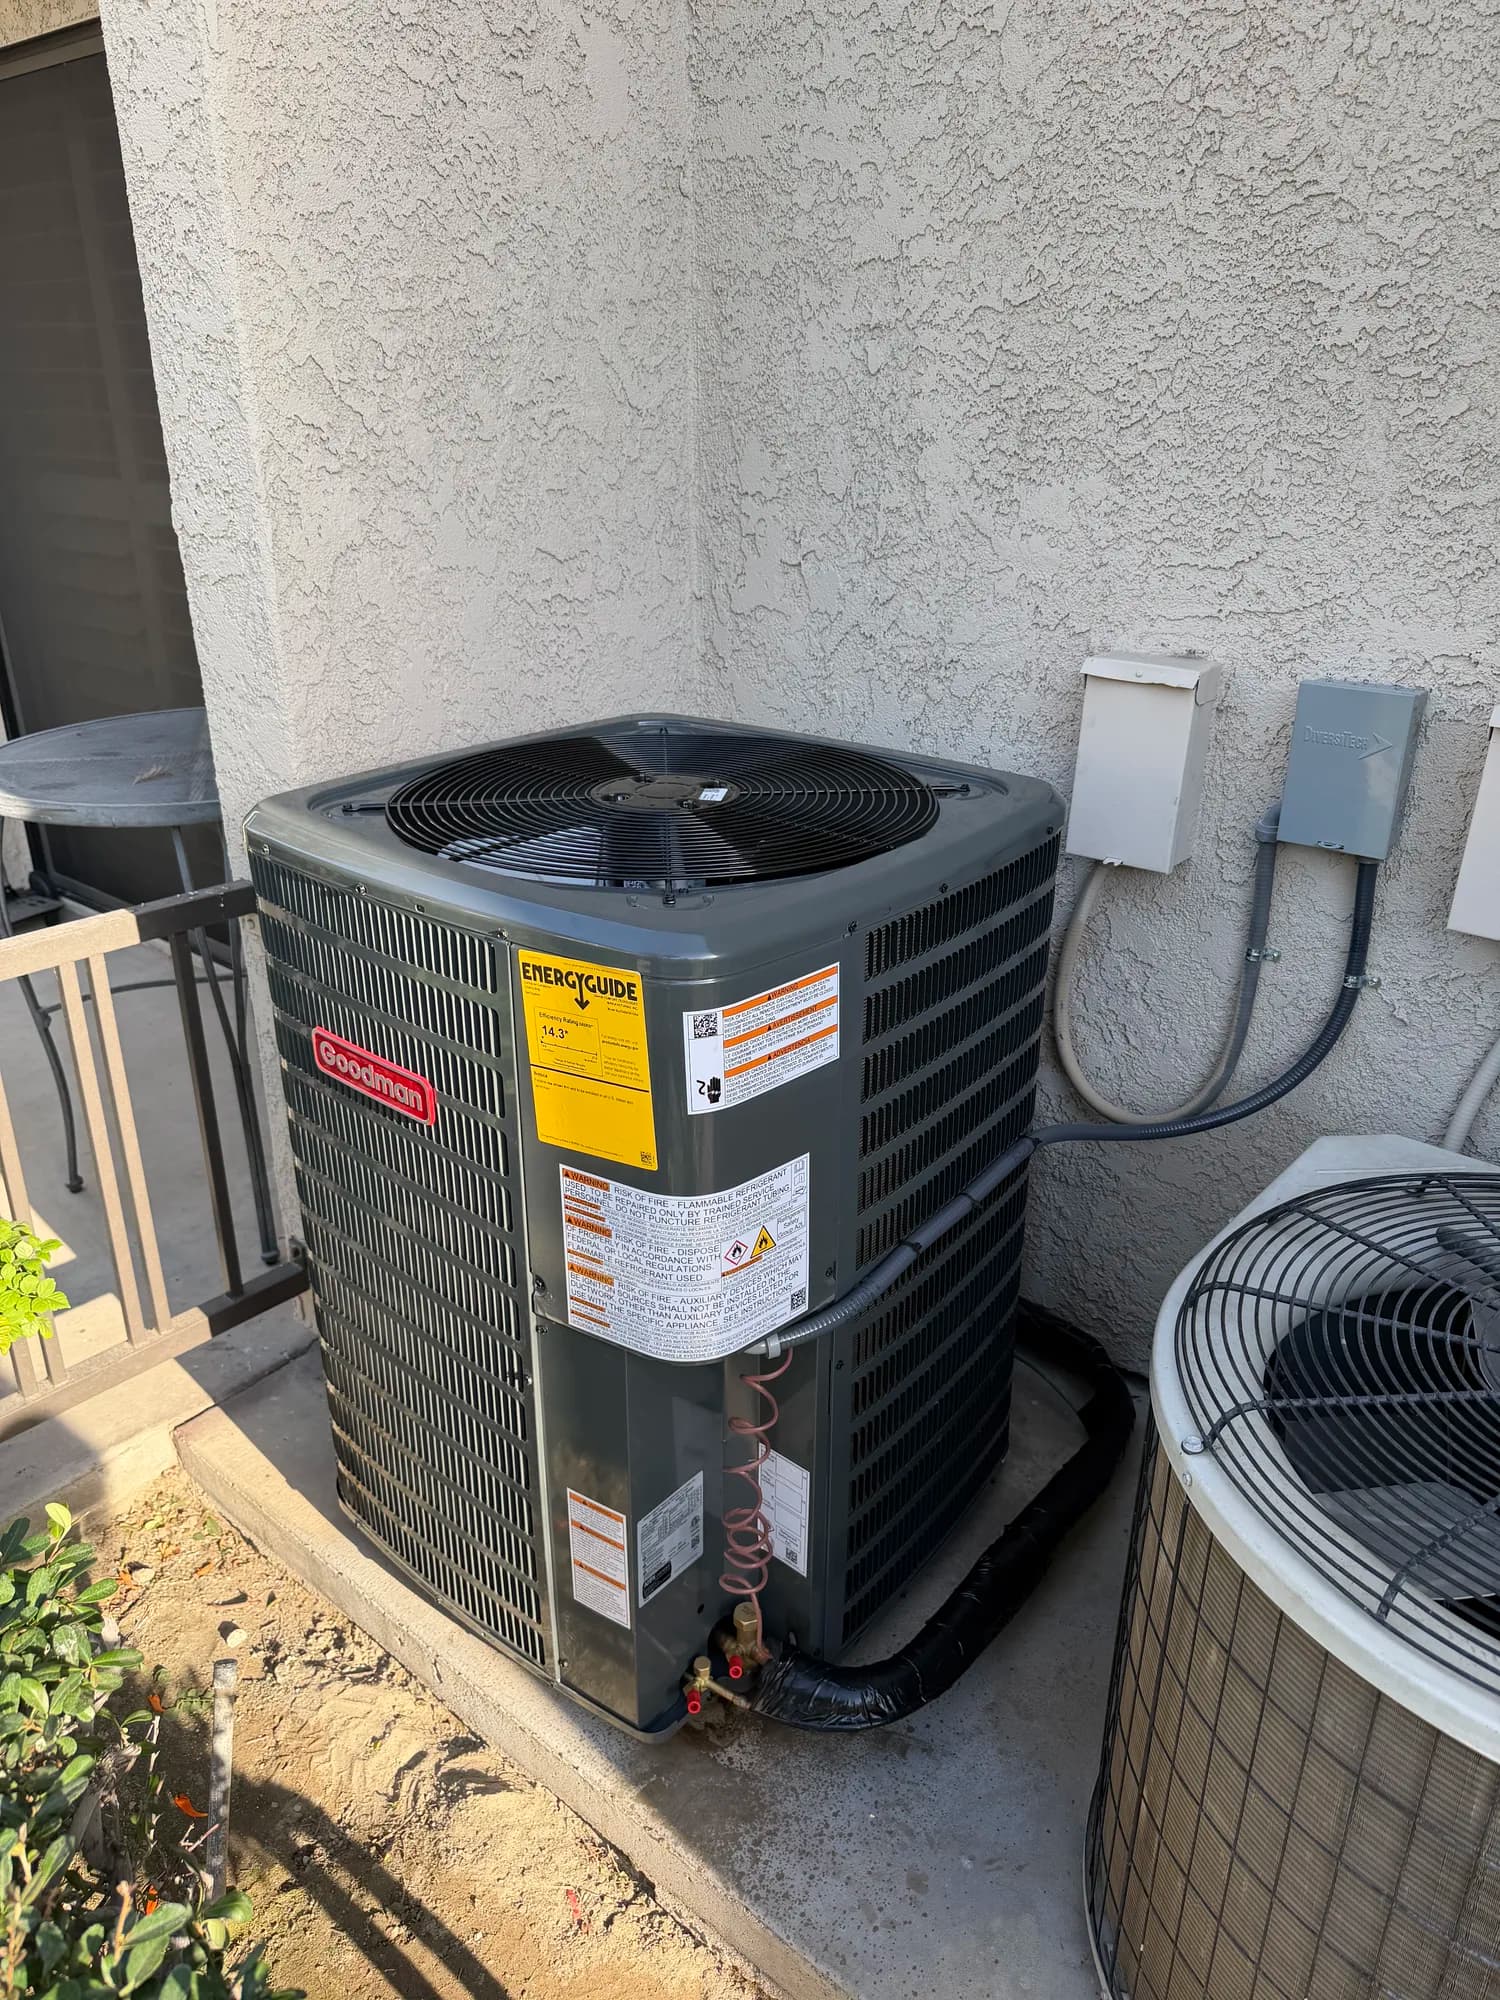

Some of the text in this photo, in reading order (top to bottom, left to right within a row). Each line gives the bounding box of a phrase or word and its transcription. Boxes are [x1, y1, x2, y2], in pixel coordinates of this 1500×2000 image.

[522, 962, 638, 1001] ENERGYGUIDE
[319, 1040, 423, 1112] Goodman
[572, 1172, 609, 1191] WARNING
[614, 1186, 632, 1199] RISK
[634, 1193, 646, 1202] OF
[648, 1197, 668, 1207] FIRE
[677, 1192, 733, 1209] FLAMMABLE
[735, 1167, 786, 1198] REFRIGERANT
[590, 1187, 601, 1198] TO
[602, 1191, 613, 1202] BE
[615, 1195, 656, 1214] REPAIRED
[658, 1208, 684, 1217] ONLY
[687, 1210, 700, 1218] BY
[703, 1198, 740, 1216] TRAINED
[742, 1182, 774, 1204] SERVICE
[615, 1203, 627, 1214] DO
[629, 1208, 646, 1219] NOT
[648, 1214, 700, 1225] PUNCTURE
[703, 1197, 761, 1224] REFRIGERANT
[566, 1224, 720, 1264] OF PROPERLY IN ACCORDANCE WITH
[568, 1232, 601, 1251] FEDERAL
[604, 1244, 615, 1255] OR
[617, 1249, 643, 1265] LOCAL
[575, 1219, 611, 1238] WARNING
[615, 1233, 633, 1245] RISK
[635, 1239, 646, 1249] OF
[649, 1244, 668, 1254] FIRE
[677, 1243, 720, 1256] DISPOSE
[567, 1240, 612, 1262] FLAMMABLE
[614, 1257, 672, 1280] REFRIGERANT
[577, 1266, 612, 1285] WARNING
[618, 1281, 636, 1294] RISK
[638, 1287, 649, 1298] OF
[651, 1293, 671, 1303] FIRE
[680, 1290, 727, 1305] AUXILIARY
[729, 1274, 762, 1296] DEVICES
[763, 1259, 787, 1280] WHICH
[789, 1254, 801, 1265] MAY
[570, 1271, 579, 1281] BE
[582, 1274, 615, 1295] IGNITION
[617, 1290, 655, 1309] SOURCES
[658, 1302, 687, 1313] SHALL
[690, 1302, 710, 1313] NOT
[712, 1299, 724, 1309] BE
[727, 1279, 766, 1304] INSTALLED
[768, 1274, 775, 1285] IN
[777, 1267, 790, 1279] THE
[571, 1288, 585, 1300] USE
[588, 1295, 607, 1307] WITH
[610, 1301, 624, 1314] THE
[627, 1308, 663, 1327] SPECIFIC
[723, 1310, 738, 1324] SEE
[618, 1296, 645, 1313] OTHER
[647, 1307, 671, 1320] THAN
[673, 1308, 721, 1321] AUXILIARY
[724, 1292, 757, 1314] DEVICES
[758, 1277, 783, 1298] LISTED
[784, 1271, 798, 1282] FOR
